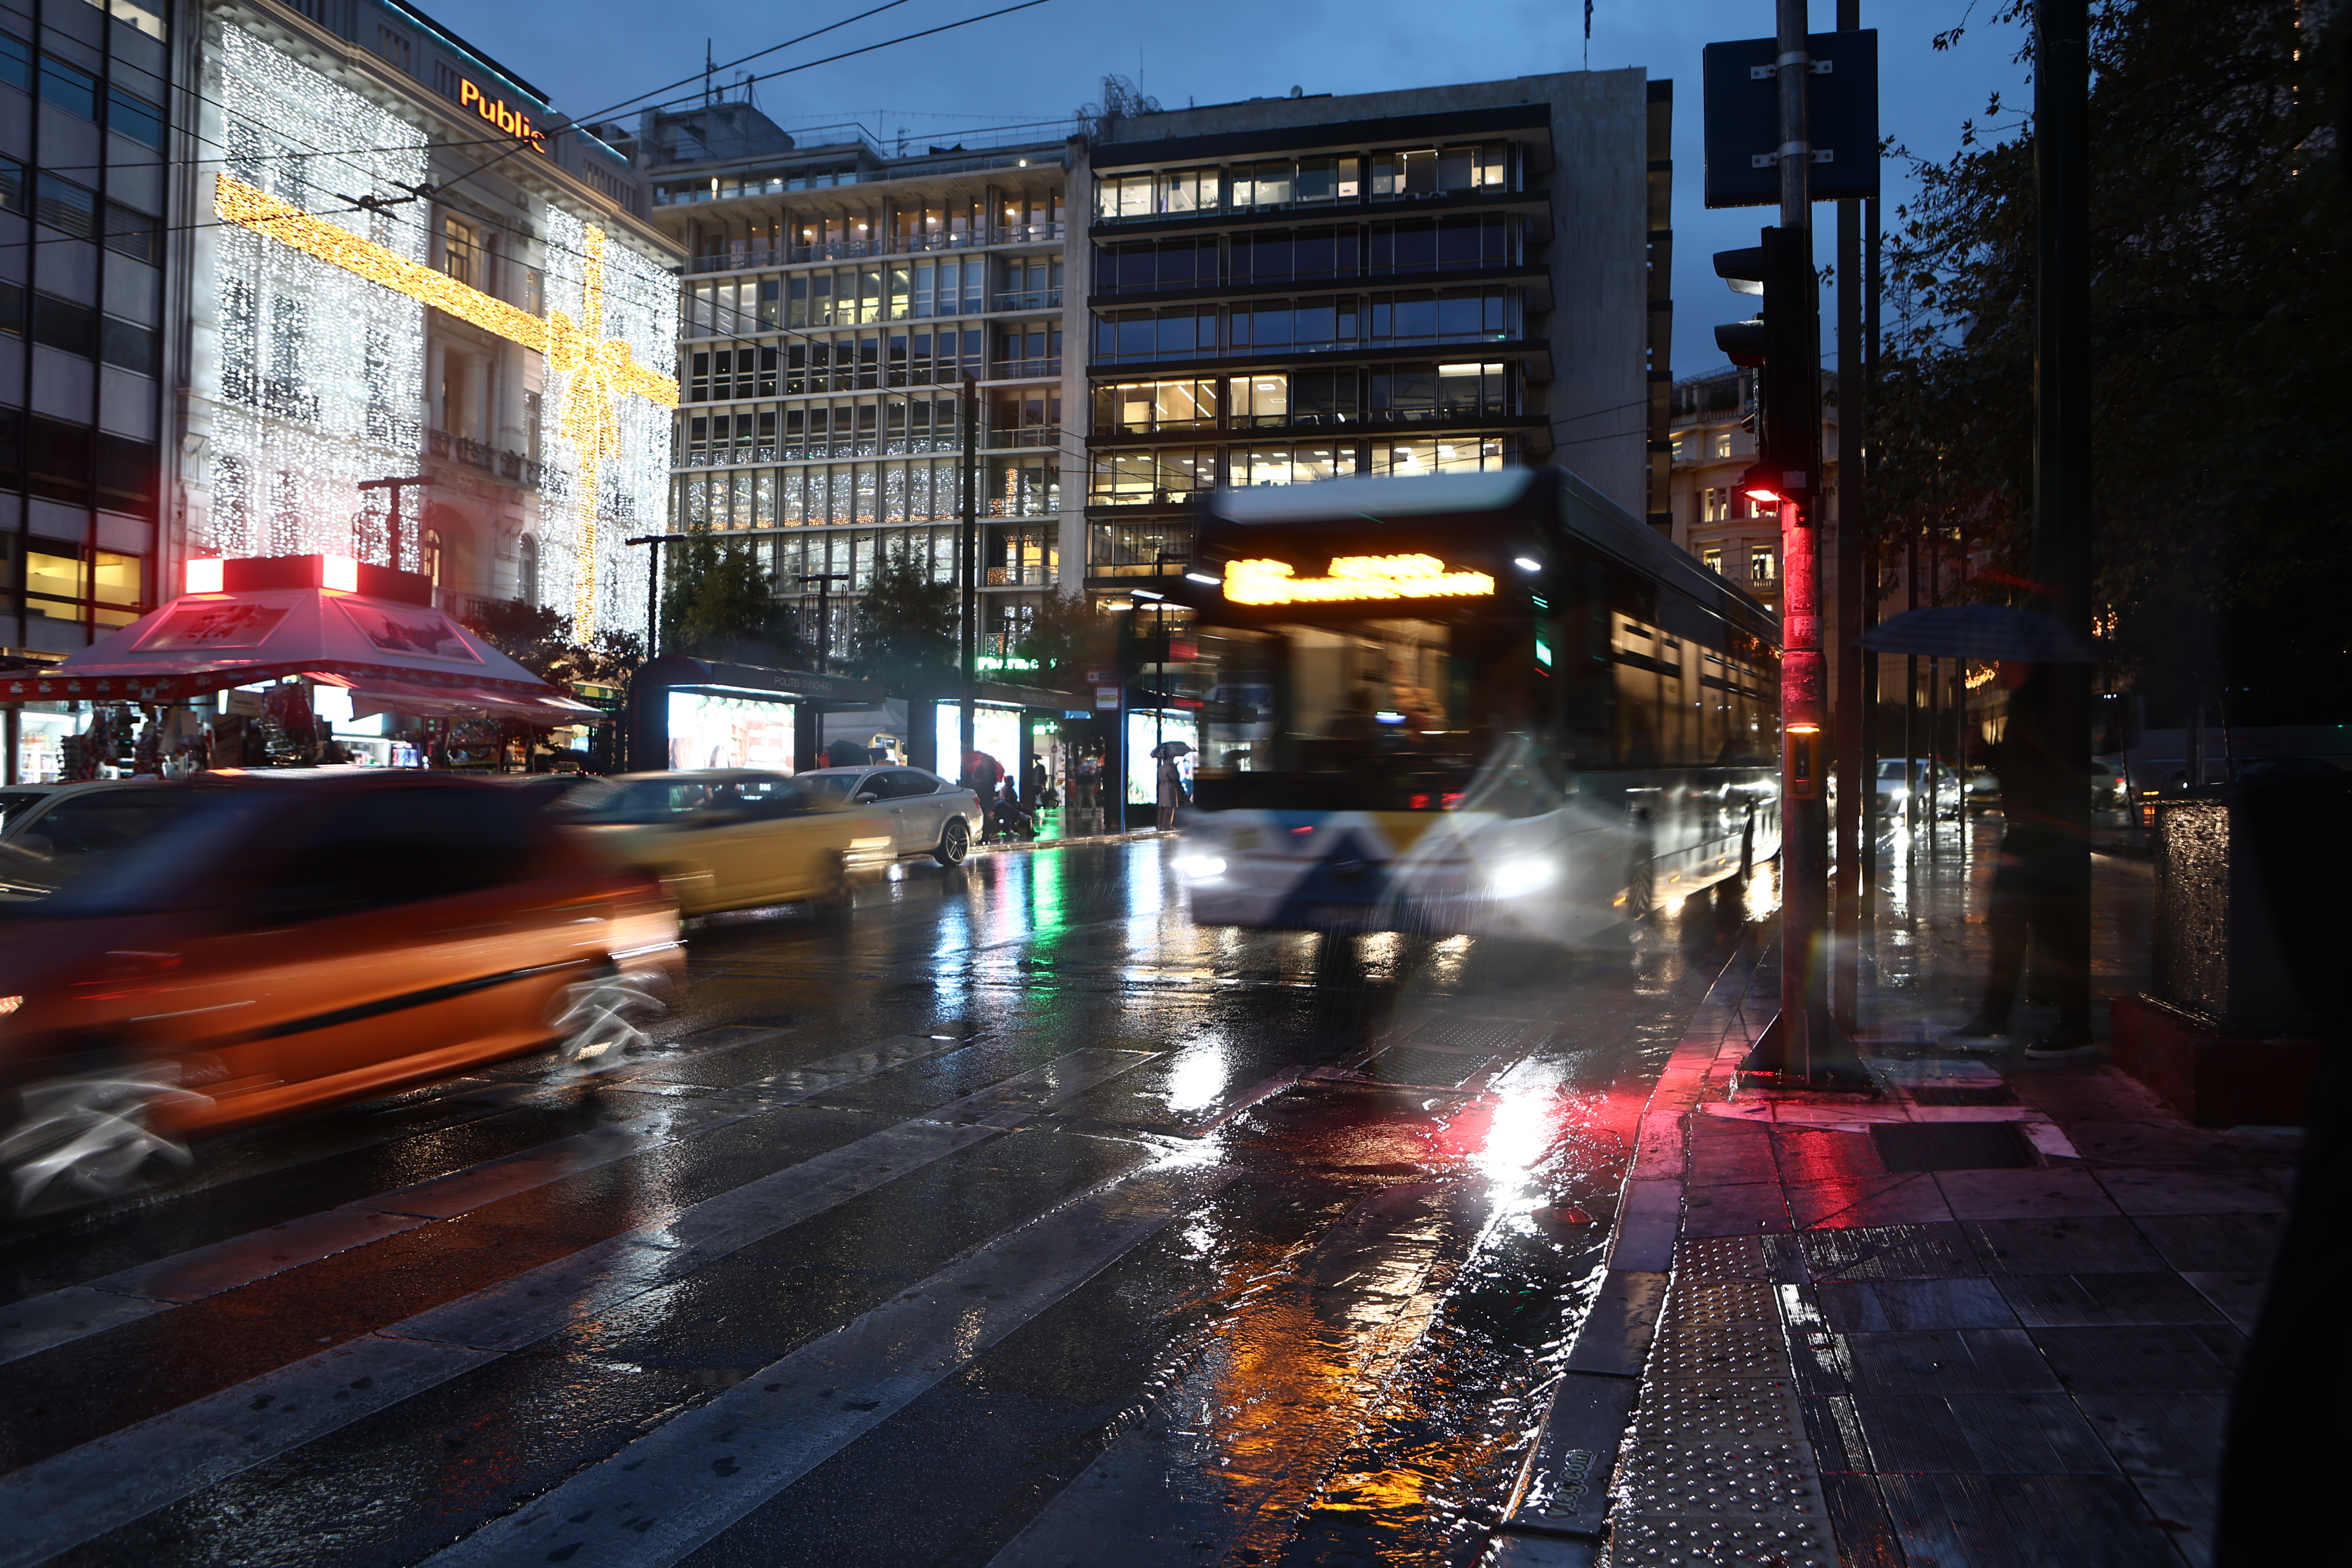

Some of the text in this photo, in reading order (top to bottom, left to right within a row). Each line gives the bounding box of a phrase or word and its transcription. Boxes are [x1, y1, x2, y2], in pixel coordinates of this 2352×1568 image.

[460, 78, 545, 154] Public
[775, 676, 832, 691] POLITIS SYNCHRO
[759, 783, 771, 791] SOS
